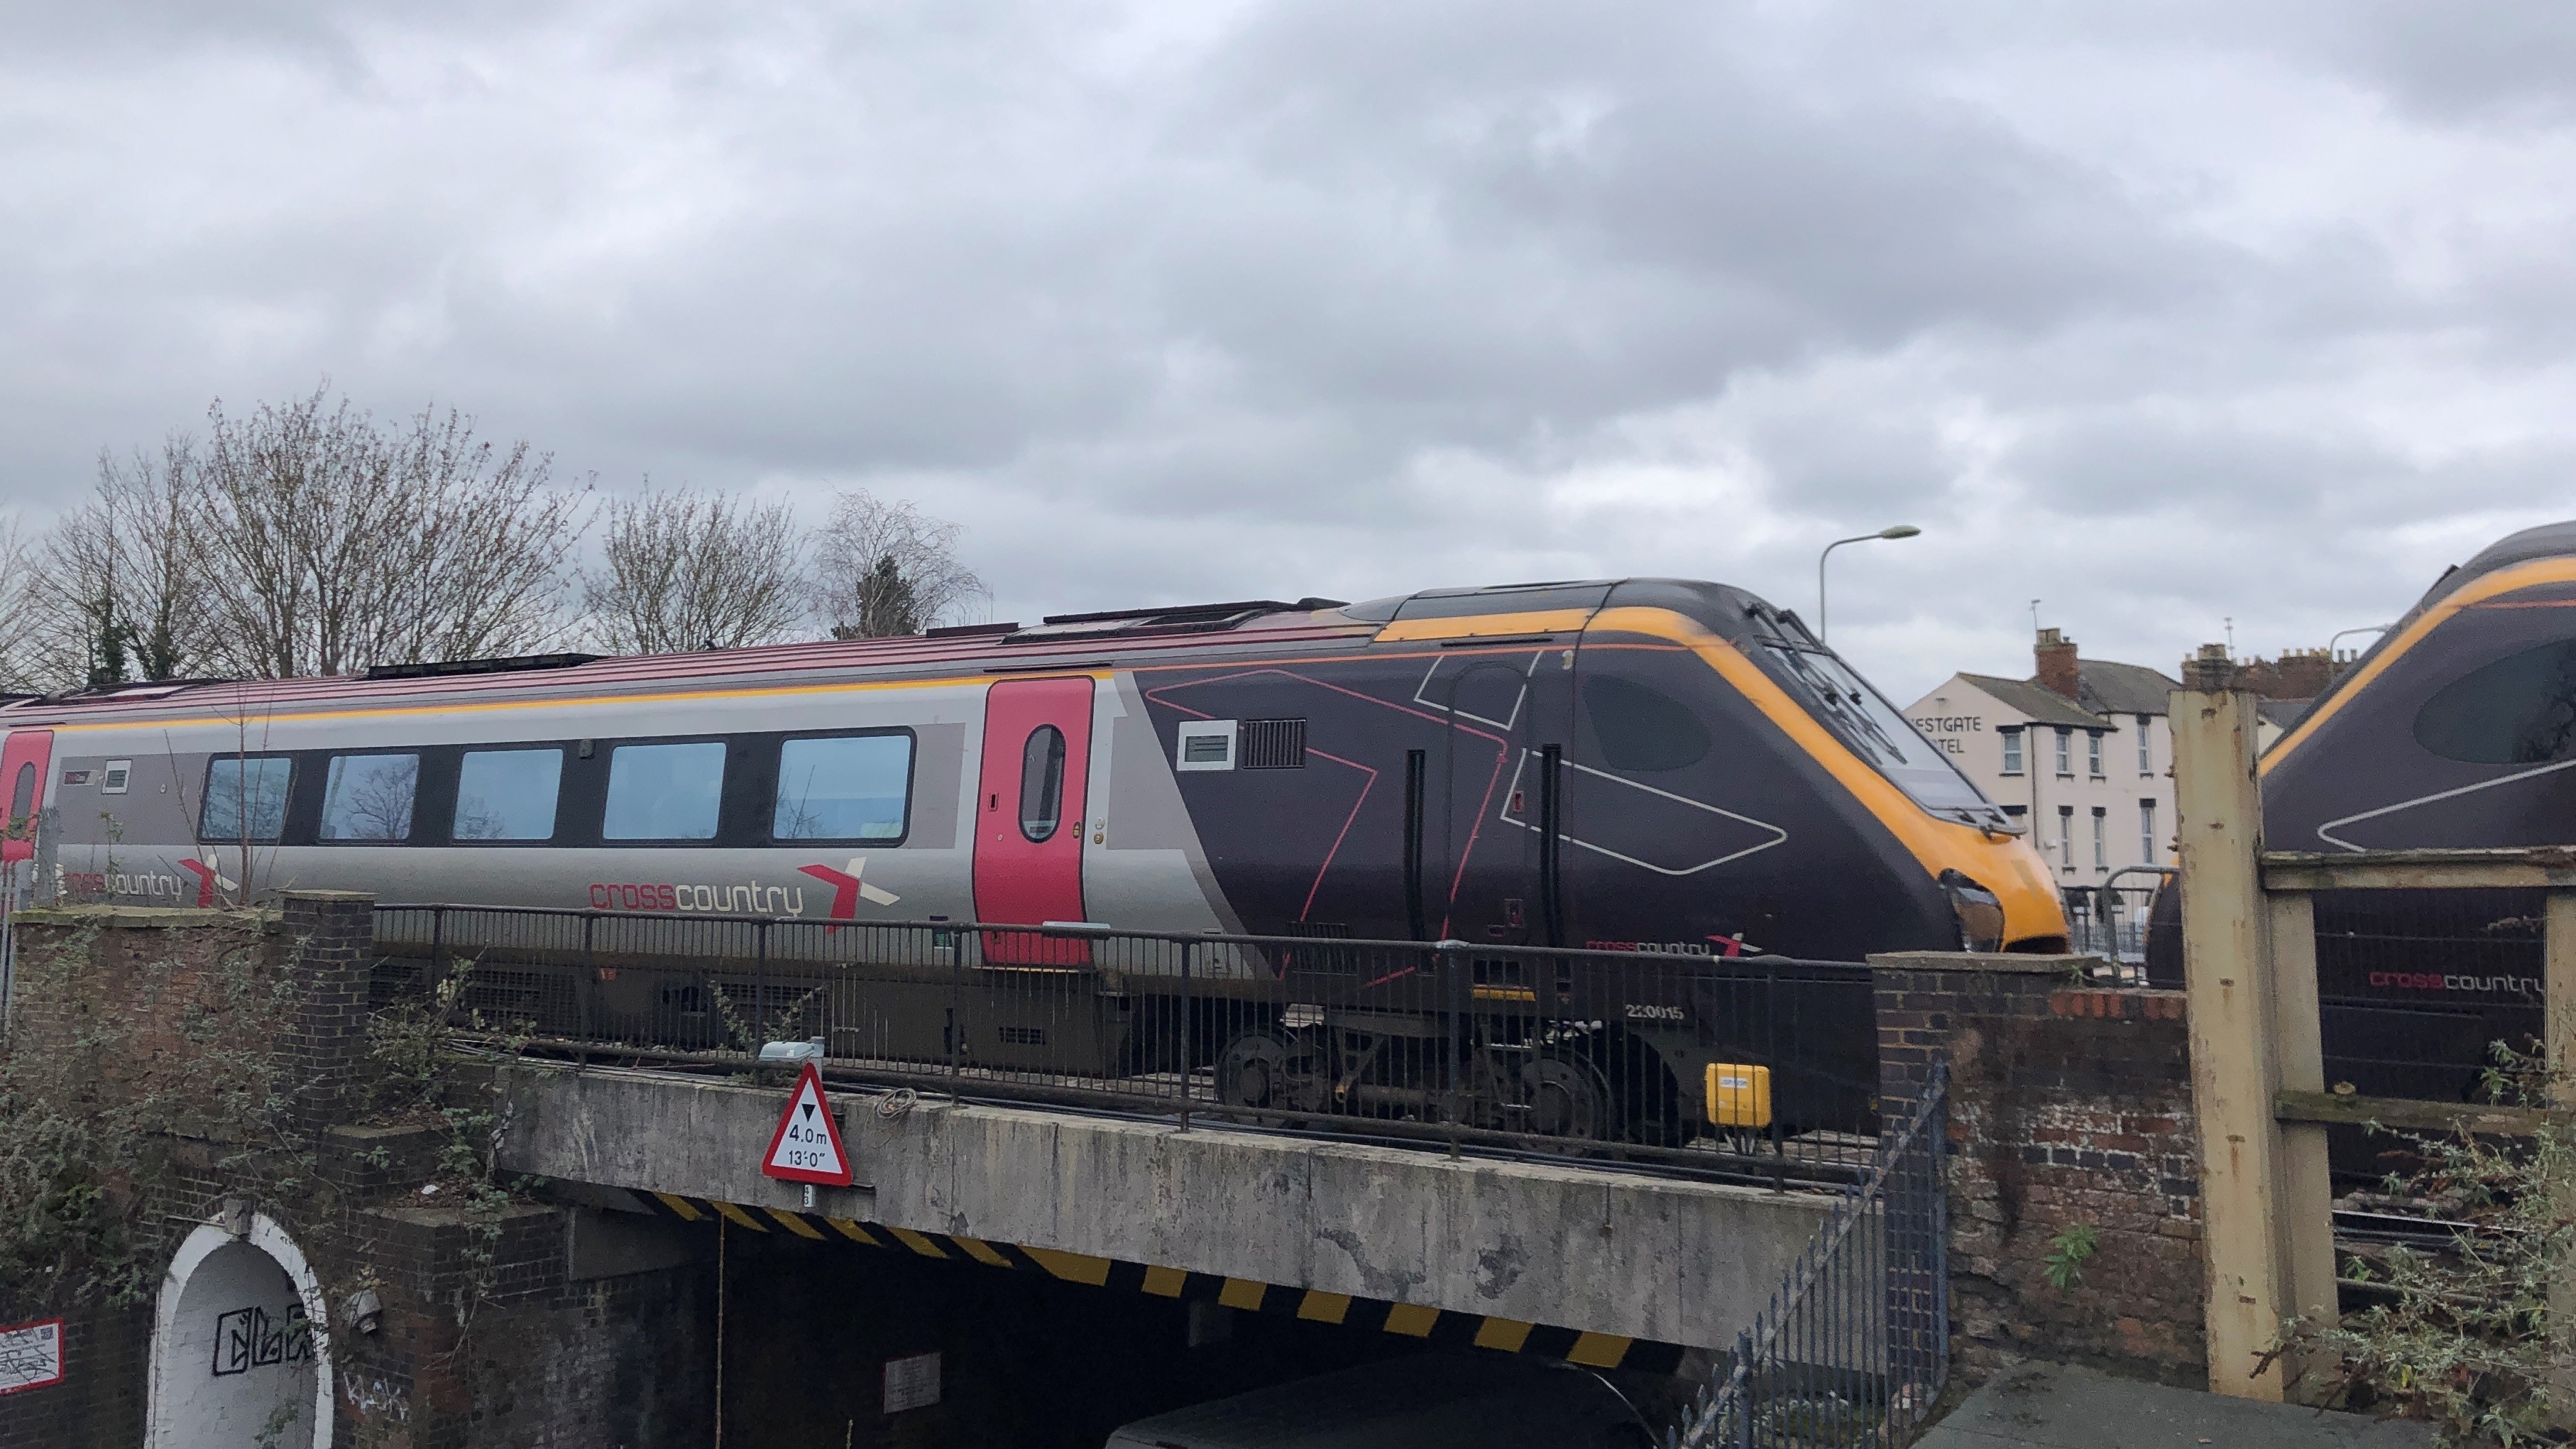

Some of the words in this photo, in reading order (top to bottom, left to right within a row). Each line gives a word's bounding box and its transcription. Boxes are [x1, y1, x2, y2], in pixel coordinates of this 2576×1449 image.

[1911, 716, 1981, 733] ESTGATE
[589, 880, 804, 917] crosscountry
[2369, 971, 2546, 995] crosscountry
[1625, 1004, 1684, 1020] 220015
[789, 1124, 814, 1144] 4.0
